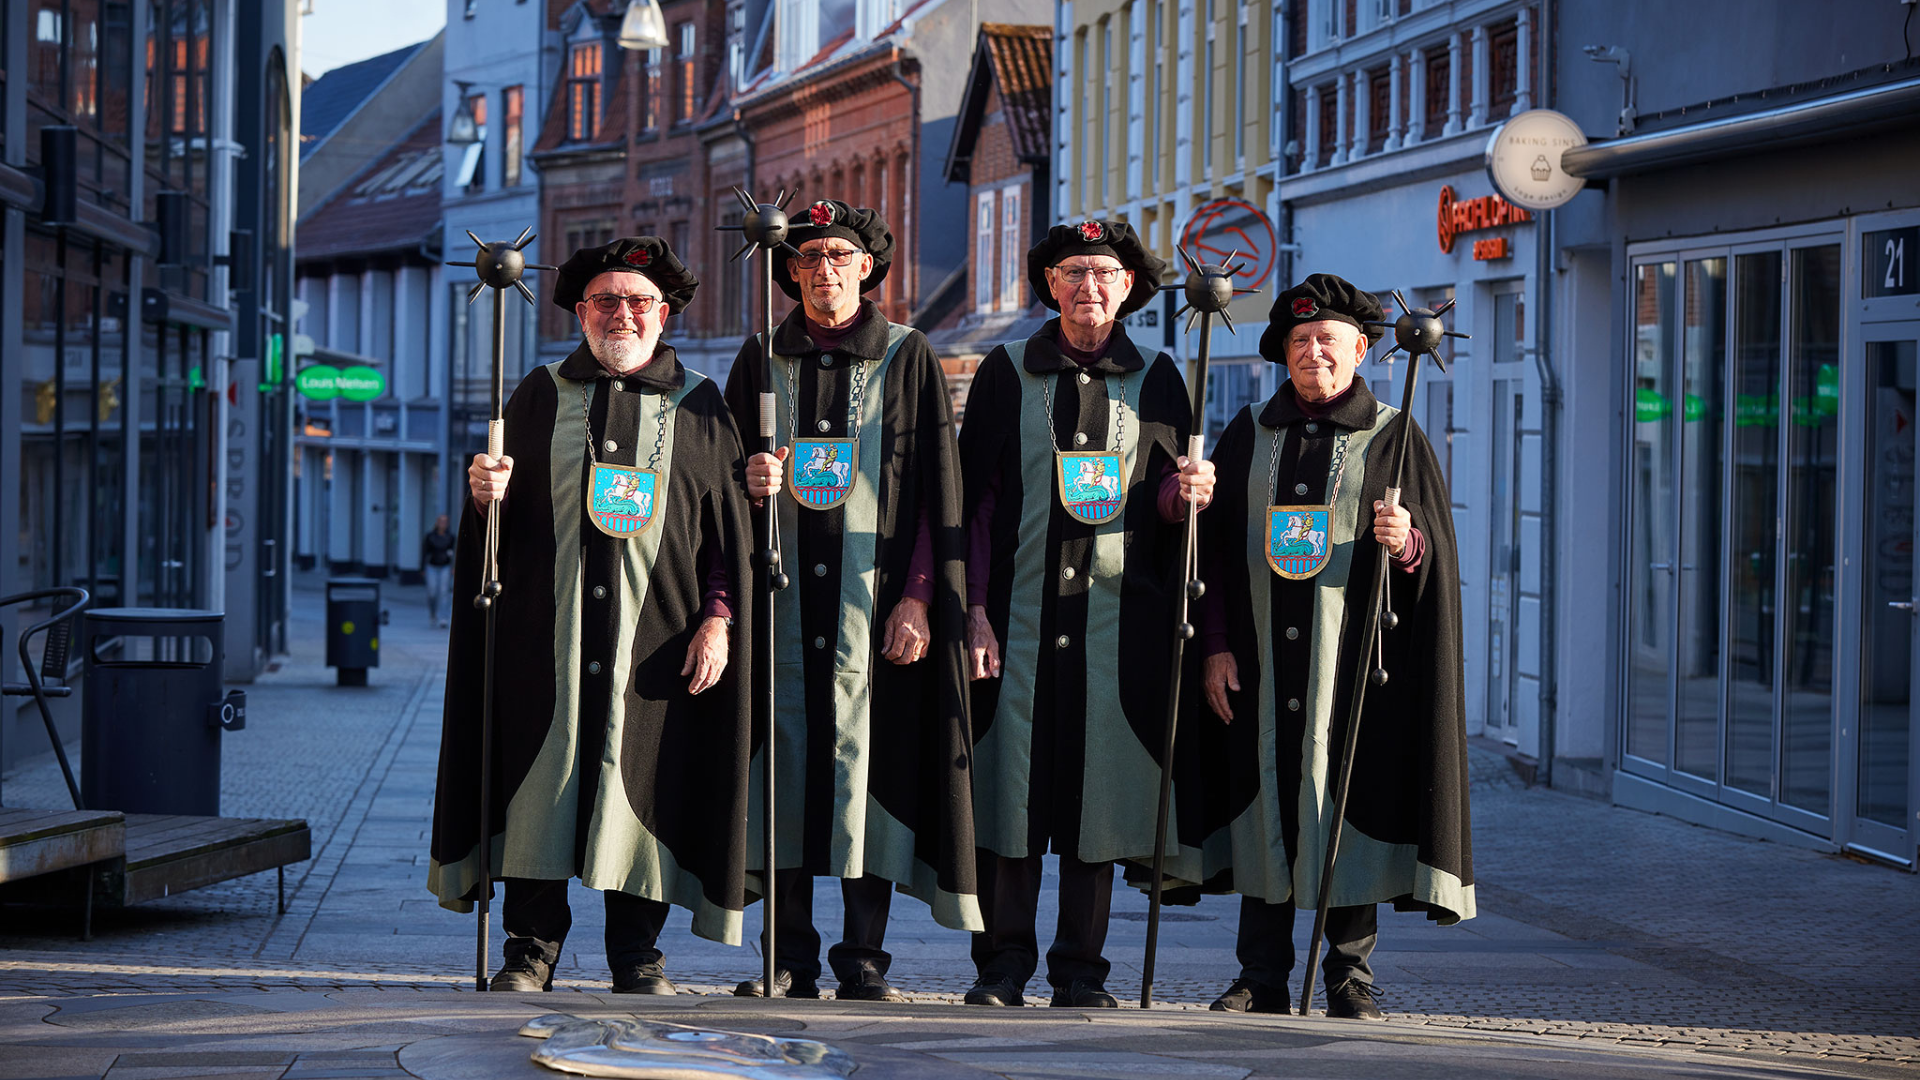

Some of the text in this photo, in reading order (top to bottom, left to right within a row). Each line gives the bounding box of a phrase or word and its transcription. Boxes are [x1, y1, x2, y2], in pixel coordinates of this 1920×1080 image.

[1509, 137, 1576, 148] BAKING SINS
[1885, 238, 1903, 288] 21
[302, 376, 334, 389] Louis
